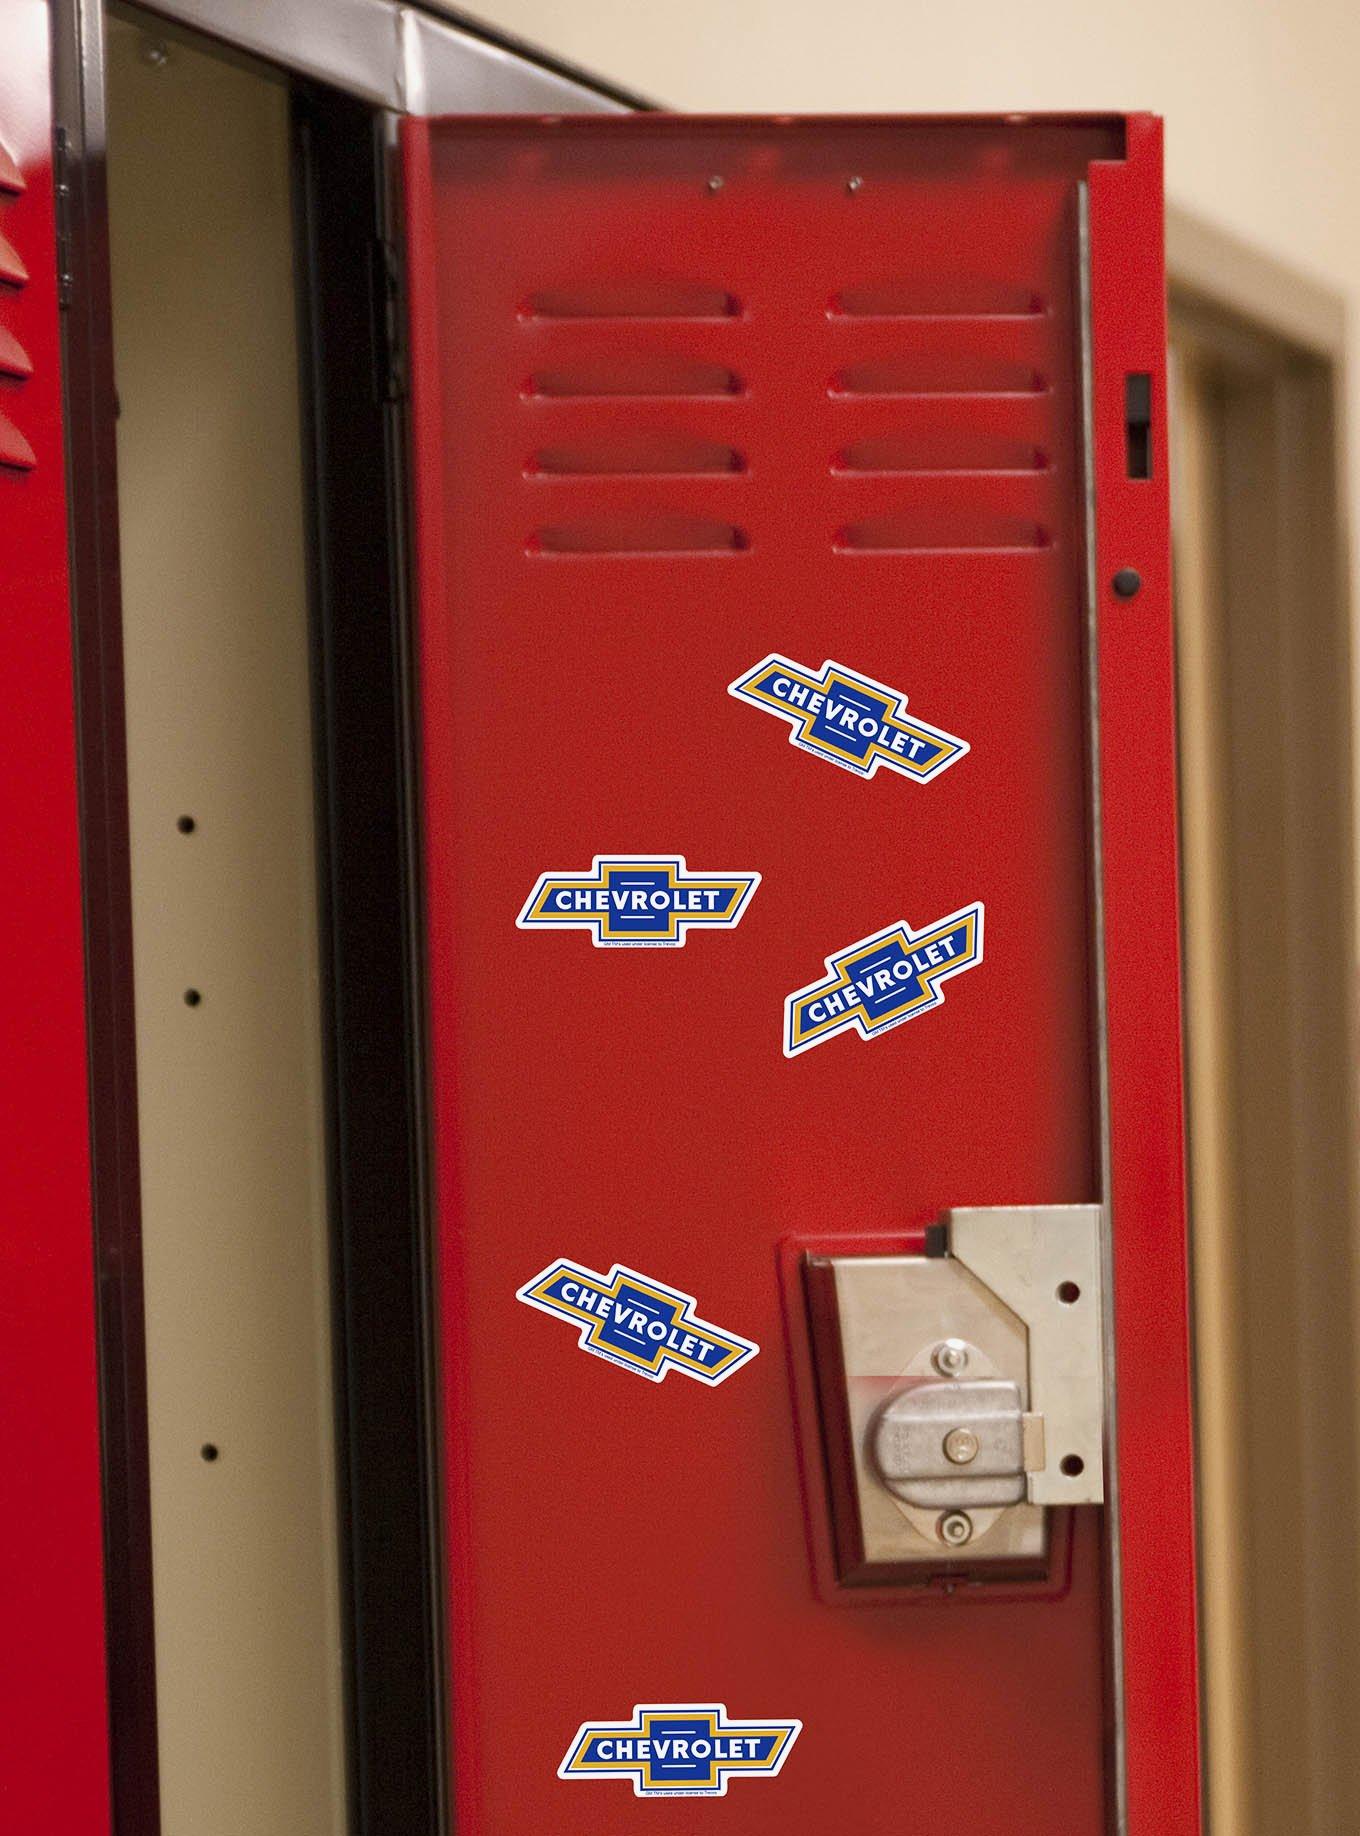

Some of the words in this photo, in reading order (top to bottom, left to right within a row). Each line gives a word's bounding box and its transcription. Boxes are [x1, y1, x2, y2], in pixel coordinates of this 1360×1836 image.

[772, 678, 926, 759] CHEVROLET
[556, 891, 719, 910] CHEVROLET
[808, 935, 955, 1022] CHEVROLET
[561, 1283, 714, 1361] CHEVROLET
[597, 1739, 760, 1760] CHEVROLET
